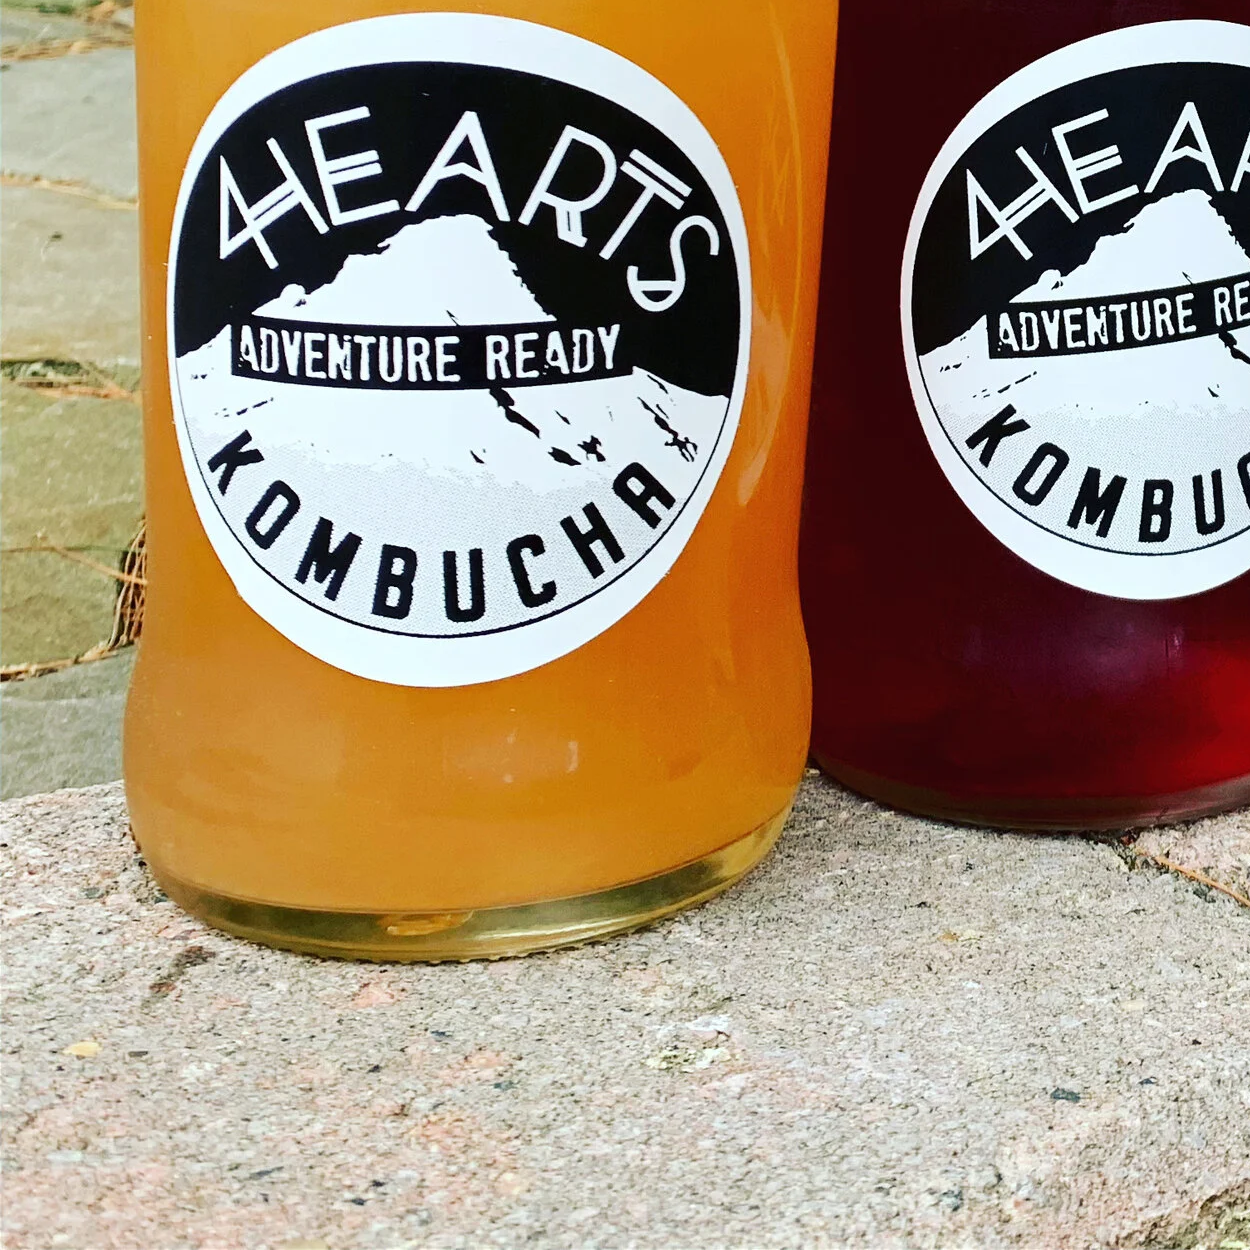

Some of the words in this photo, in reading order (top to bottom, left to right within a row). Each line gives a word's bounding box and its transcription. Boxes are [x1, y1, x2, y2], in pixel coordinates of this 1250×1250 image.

[998, 292, 1197, 352] ADVENTURE
[238, 325, 462, 383] ADVENTURE
[485, 323, 621, 379] READY
[207, 429, 676, 622] KOMBUCHA
